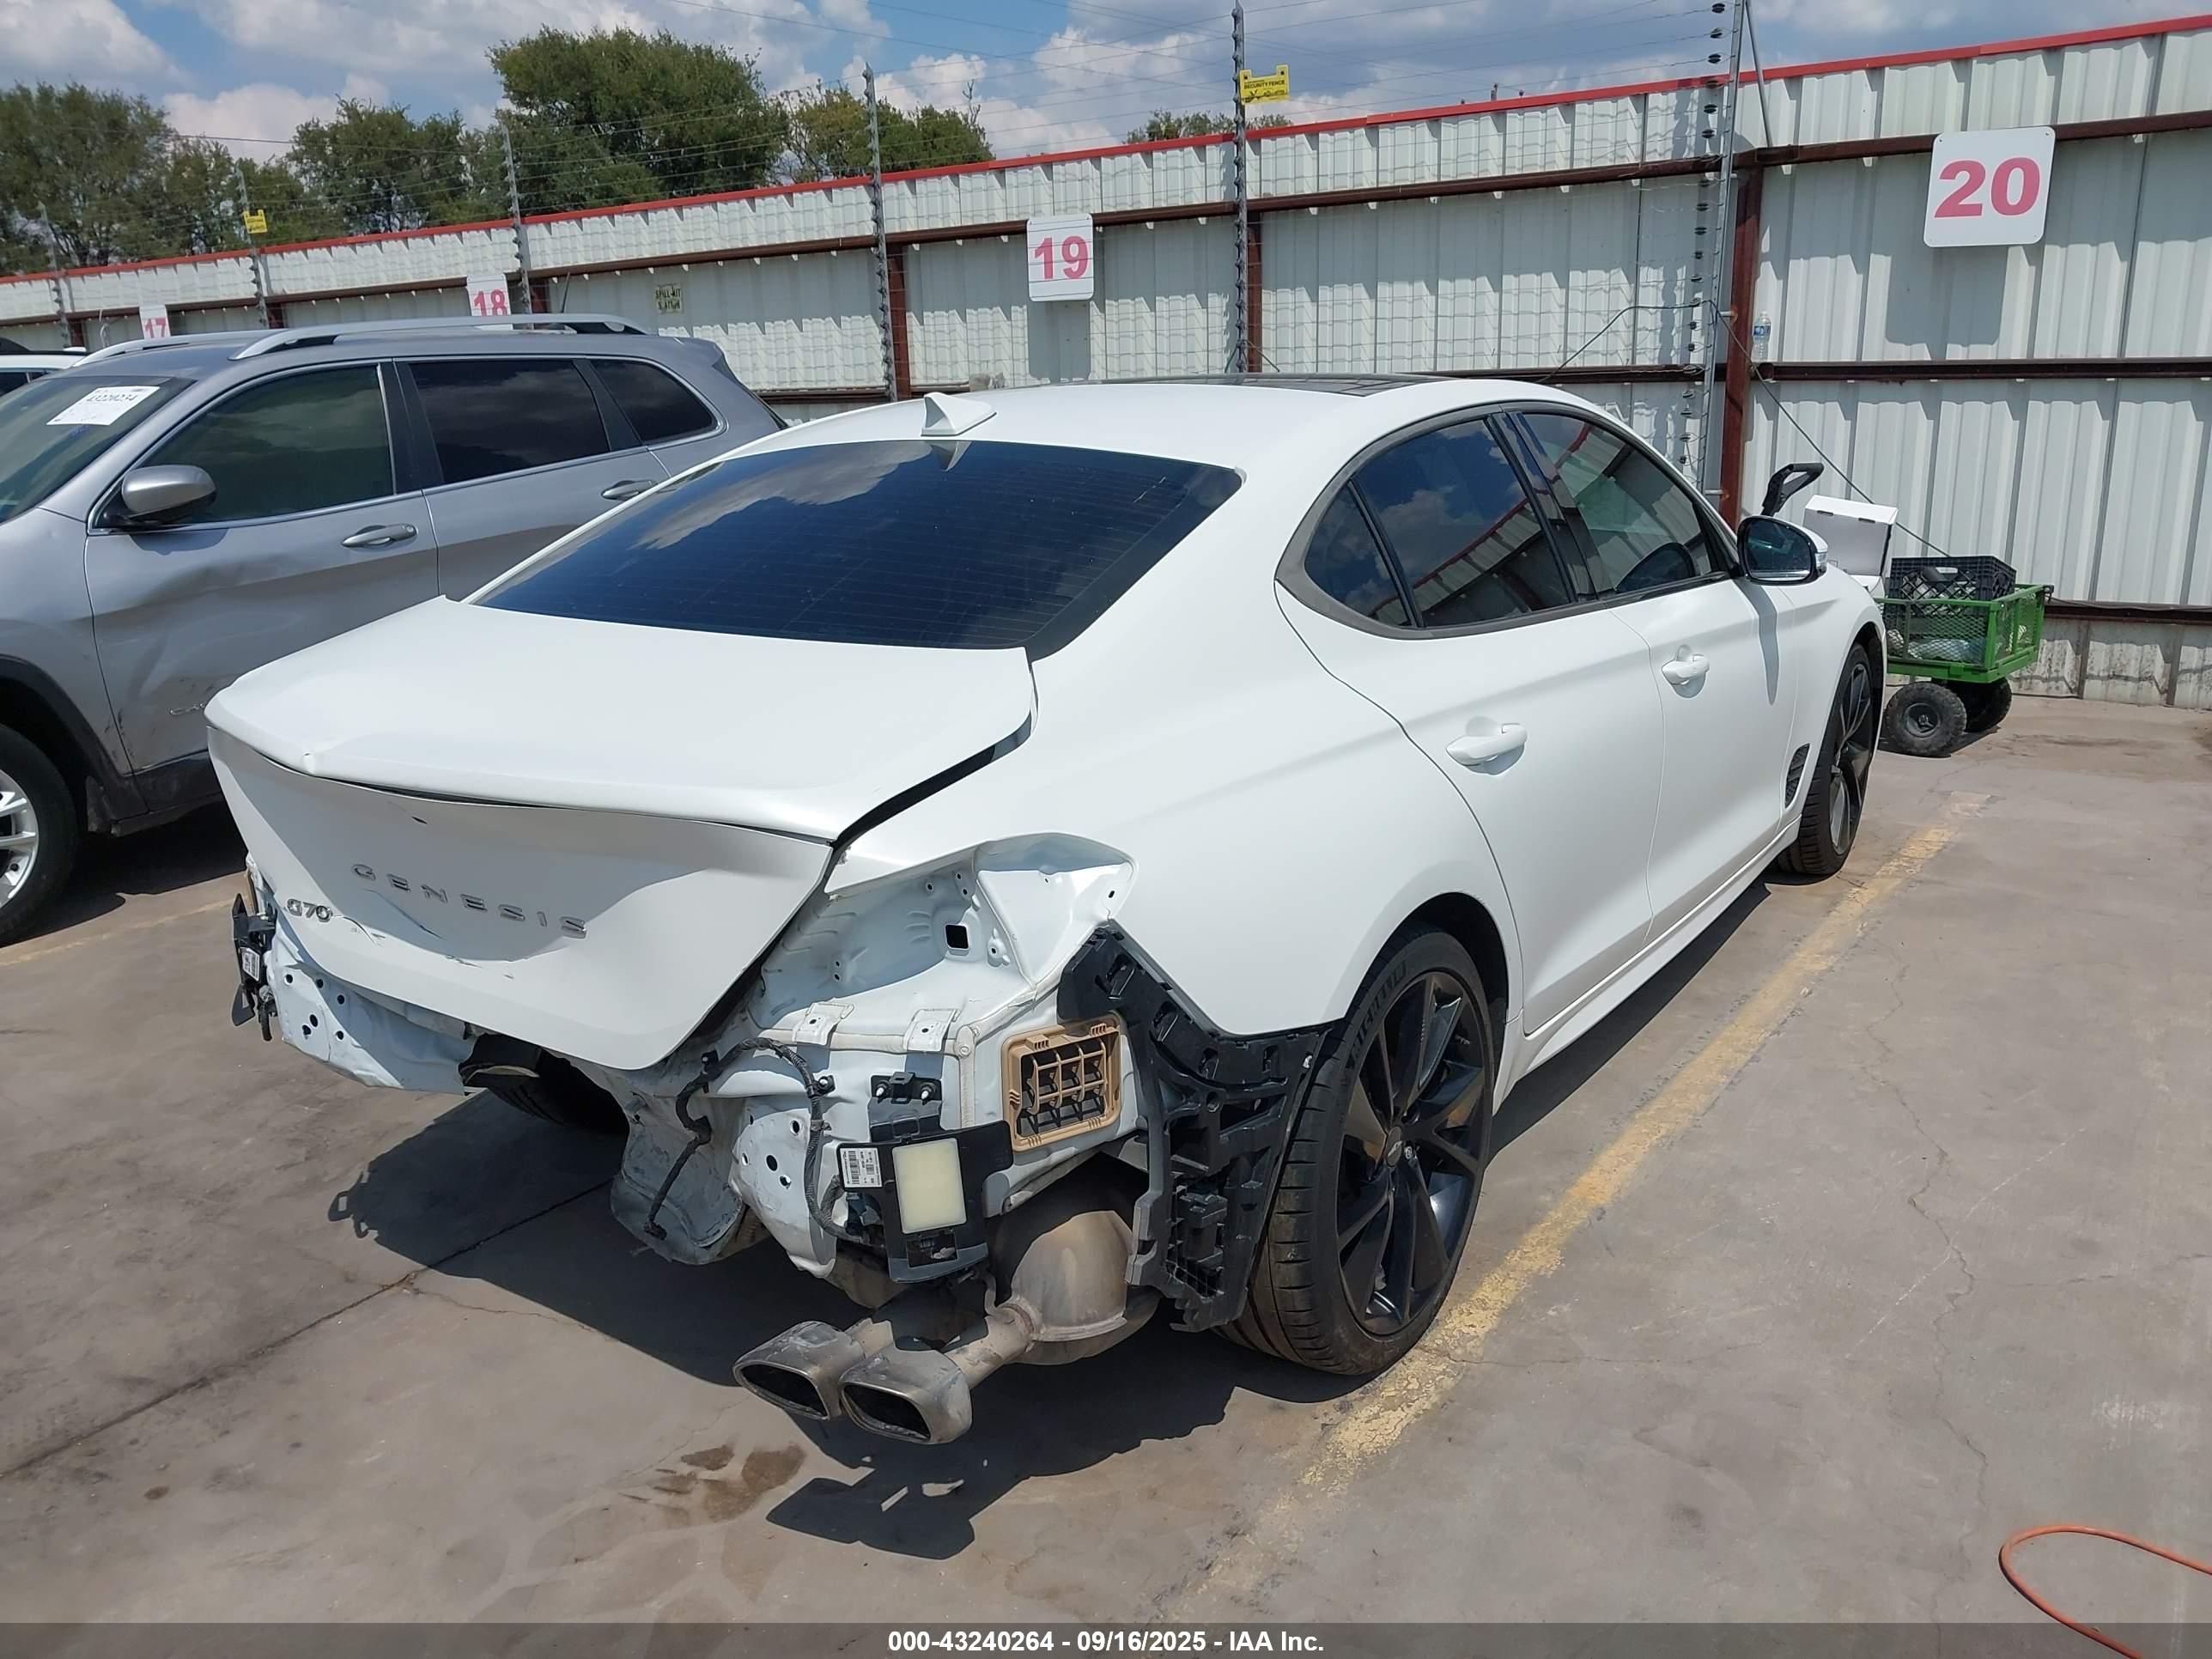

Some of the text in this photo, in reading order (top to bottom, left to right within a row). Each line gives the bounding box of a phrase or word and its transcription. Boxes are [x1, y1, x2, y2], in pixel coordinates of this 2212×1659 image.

[1934, 157, 2040, 218] 20
[1034, 235, 1088, 280] 19
[474, 289, 507, 316] 18
[144, 317, 166, 338] 17
[287, 898, 332, 923] G70
[351, 864, 587, 939] GENESIS
